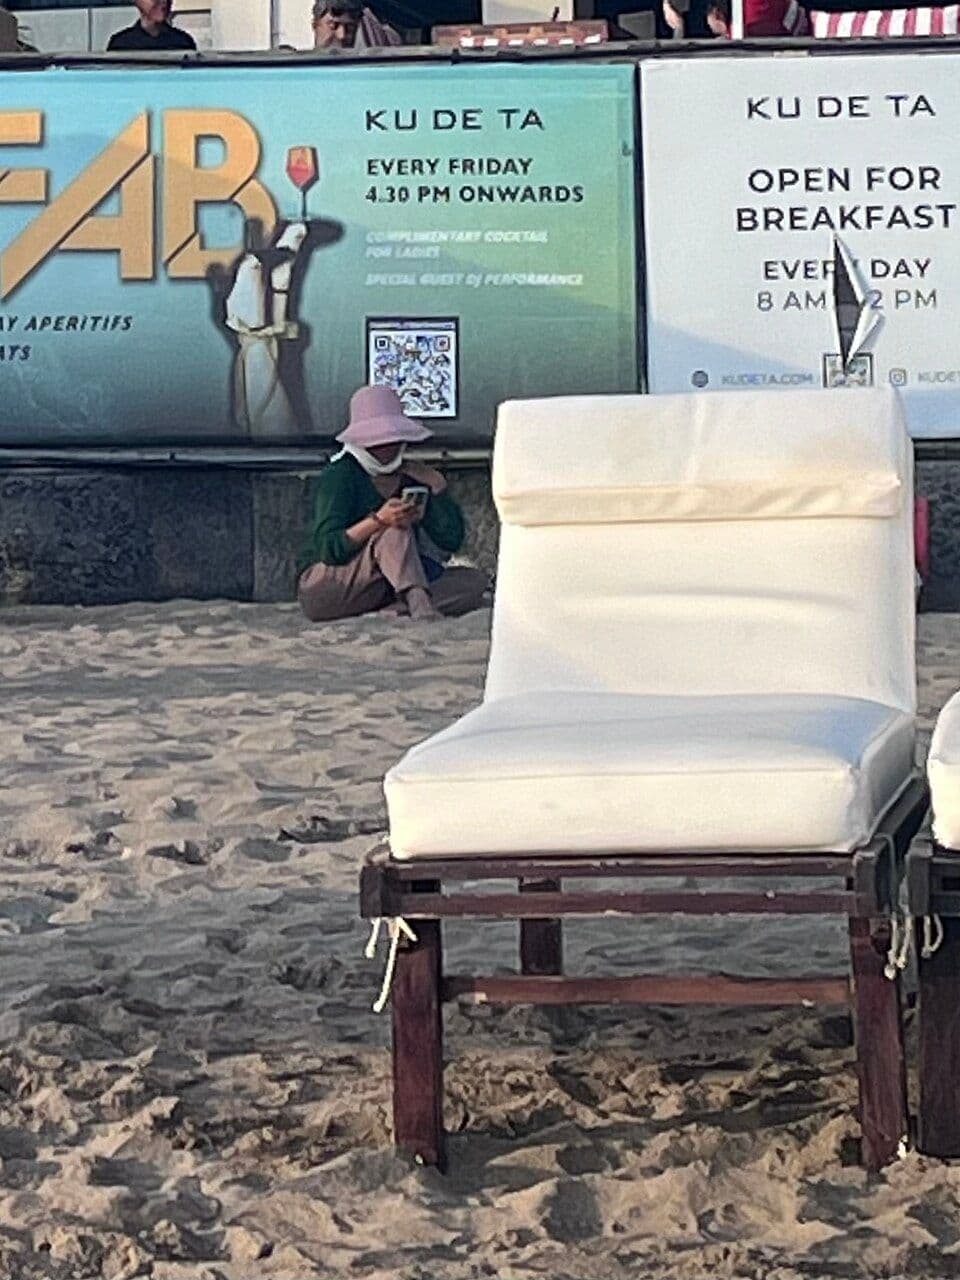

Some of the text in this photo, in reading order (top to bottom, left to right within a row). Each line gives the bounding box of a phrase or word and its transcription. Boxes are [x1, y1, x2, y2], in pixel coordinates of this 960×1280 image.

[746, 94, 936, 119] KU DE TA
[365, 108, 545, 131] KU DE TA
[366, 157, 534, 176] EVERY FRIDAY
[747, 166, 942, 194] OPEN FOR
[365, 185, 584, 203] 4.30 PM ONWARDS
[736, 205, 957, 232] BREAKFAST
[764, 257, 931, 281] EVER DAY
[757, 291, 773, 312] 8
[783, 290, 827, 311] AM
[895, 288, 937, 310] PM
[24, 315, 134, 332] APERITIFS
